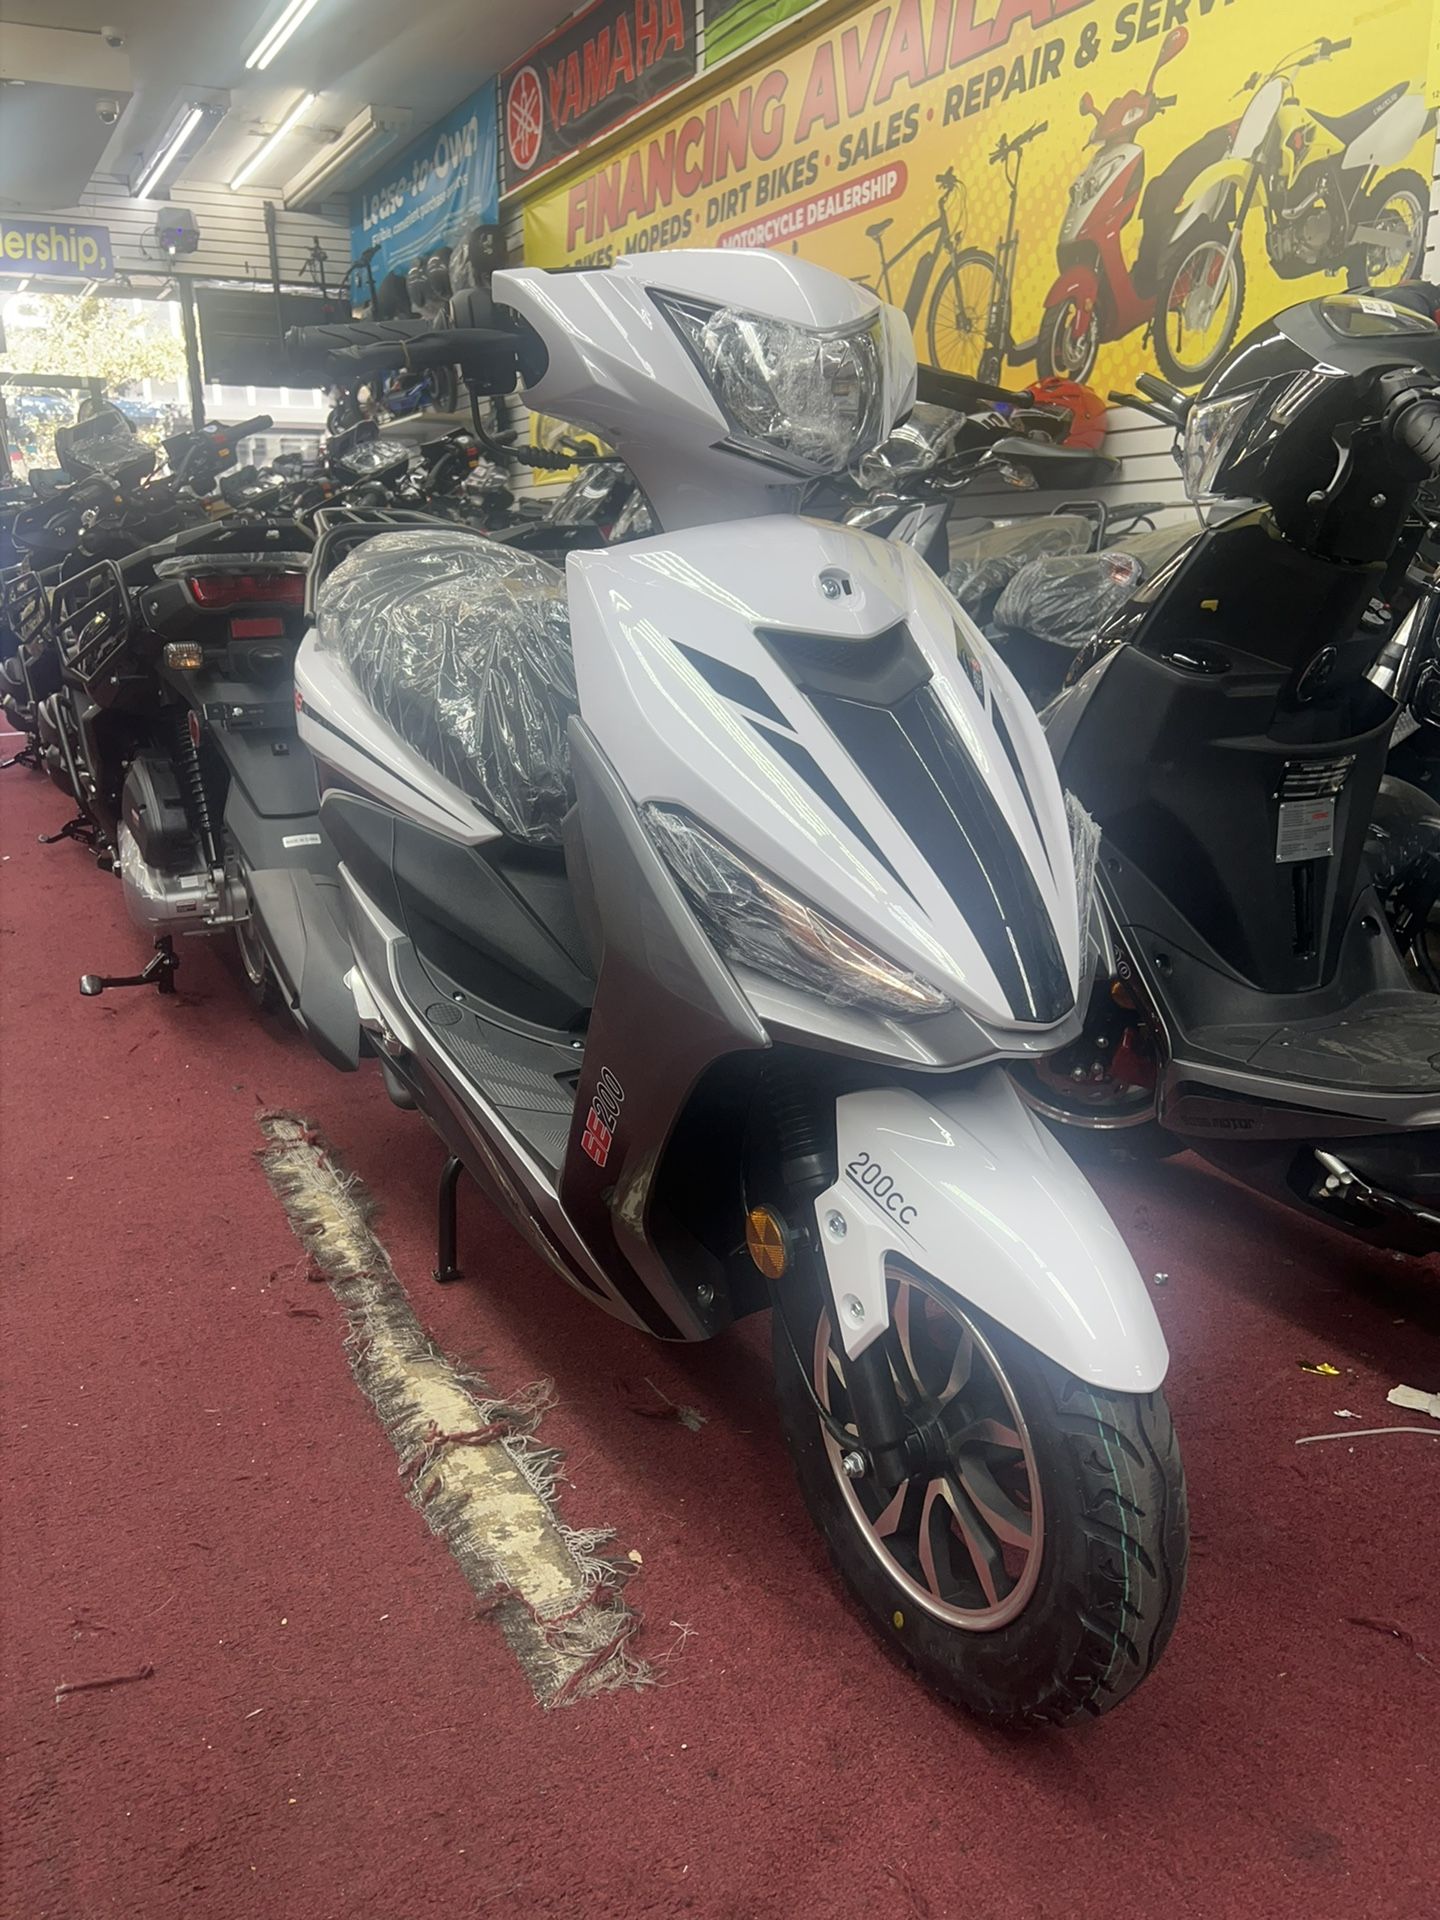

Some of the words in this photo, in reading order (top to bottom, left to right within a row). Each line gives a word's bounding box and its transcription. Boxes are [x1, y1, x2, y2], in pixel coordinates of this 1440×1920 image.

[547, 0, 685, 132] YAMAHA
[566, 69, 788, 253] FINANCING
[794, 0, 1095, 144] AVAIL
[625, 208, 693, 254] MOPEDS
[706, 181, 752, 228] DIRT
[755, 150, 819, 207] BIKES
[837, 103, 920, 171] SALES
[942, 38, 1065, 126] REPAIR
[1074, 21, 1101, 68] &
[1111, 0, 1235, 52] SER
[807, 170, 898, 226] DEALERSHIP
[581, 1066, 624, 1168] SE200
